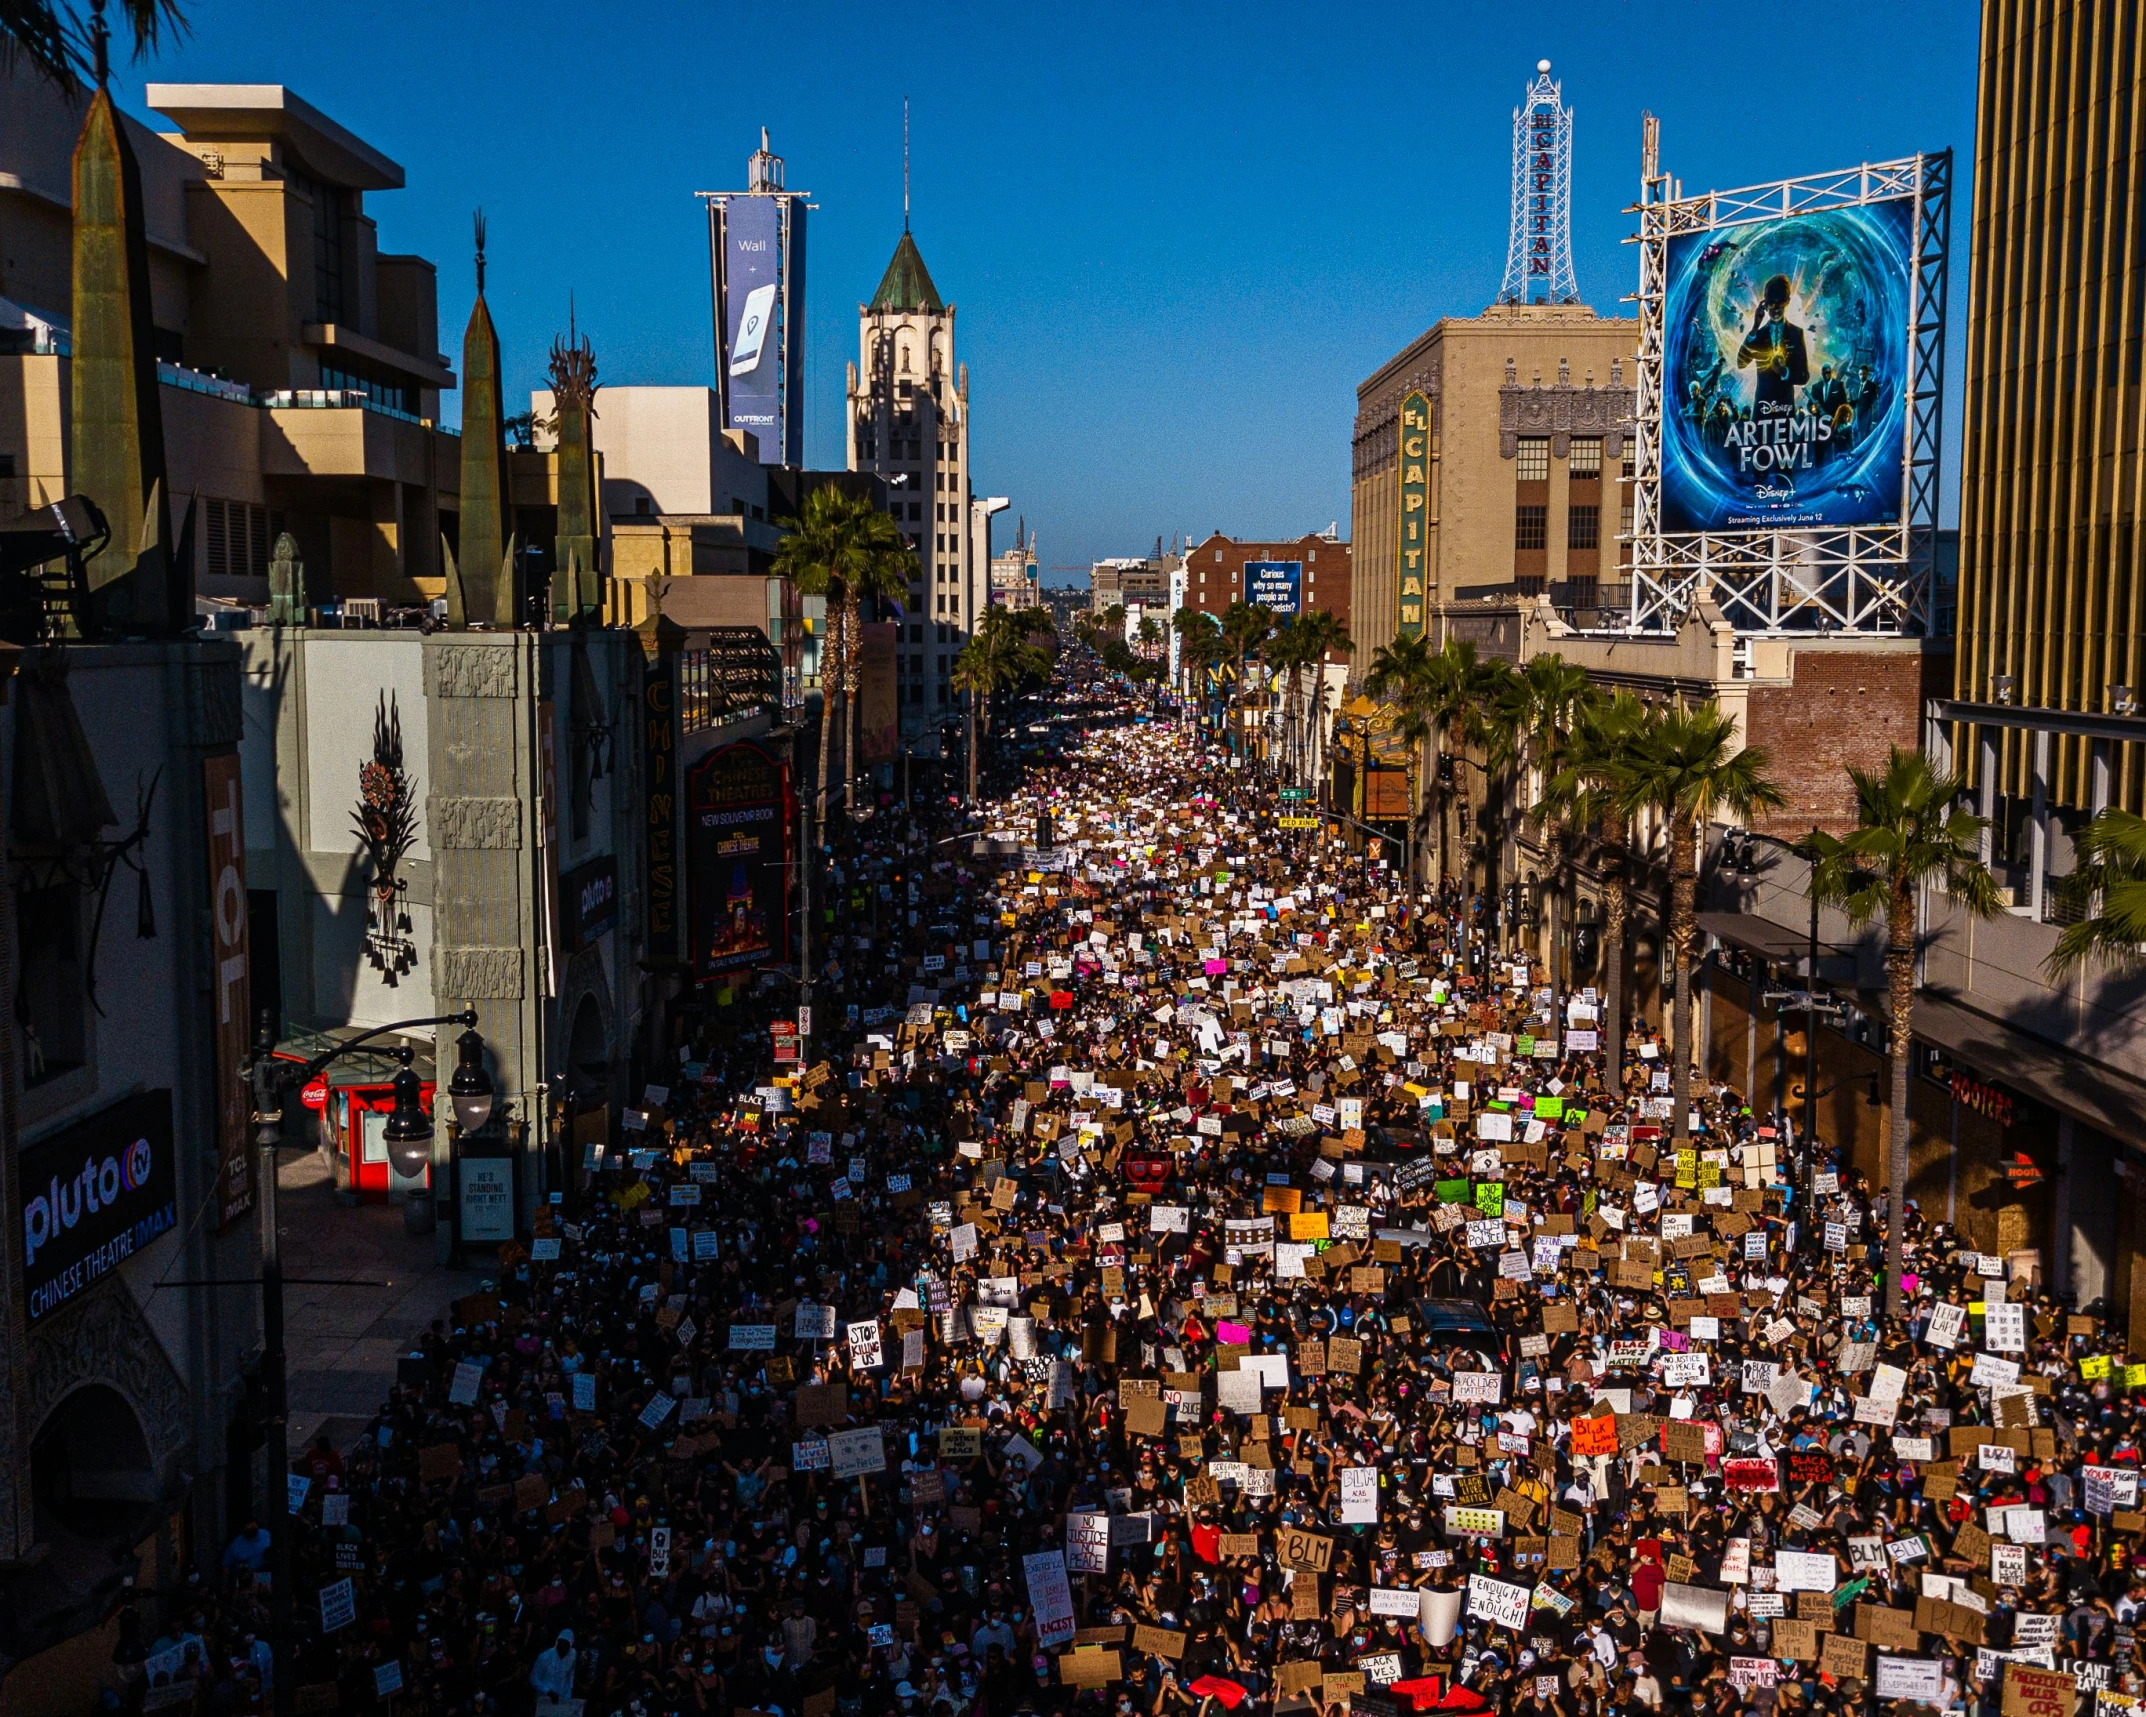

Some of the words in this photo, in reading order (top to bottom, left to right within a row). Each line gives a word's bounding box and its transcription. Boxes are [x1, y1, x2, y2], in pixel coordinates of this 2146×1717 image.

[1530, 131, 1553, 275] CAPITAN
[738, 240, 766, 252] Wall
[734, 415, 774, 423] OUTFRONT
[1404, 409, 1427, 431] EL
[1723, 414, 1832, 448] ARTEMIS
[1740, 442, 1813, 472] FOWL
[1728, 515, 1760, 525] Streaming
[1761, 513, 1796, 524] Exclusively
[1797, 513, 1814, 521] June
[1814, 512, 1823, 520] 12
[1402, 436, 1424, 624] CAPITAN
[1260, 568, 1285, 579] Curious
[1252, 580, 1266, 592] why
[1266, 582, 1275, 590] so
[1275, 582, 1293, 592] many
[1256, 592, 1277, 603] people
[1277, 593, 1288, 601] are
[647, 680, 673, 933] CHINESE
[702, 814, 719, 826] NEW
[720, 809, 754, 824] SOUVENIR
[756, 808, 775, 820] BOOK
[582, 879, 604, 920] pluto
[716, 958, 728, 968] SALE
[739, 1094, 763, 1105] BLACK
[745, 1112, 759, 1121] NOT
[1605, 1126, 1627, 1134] DEFUND
[1603, 1136, 1627, 1146] POLICE
[1678, 1149, 1695, 1159] BLACK
[228, 1154, 248, 1176] TCL
[1677, 1160, 1695, 1168] LIVES
[478, 1172, 494, 1182] HE'S
[468, 1183, 503, 1193] STANDING
[466, 1194, 487, 1204] RIGHT
[488, 1194, 507, 1203] NEXT
[25, 1156, 119, 1266] pluto
[1468, 1219, 1503, 1232] ABOLISH
[1468, 1231, 1504, 1246] POLICE!
[1536, 1235, 1561, 1245] DEFUND
[30, 1267, 83, 1319] CHINESE
[84, 1228, 134, 1283] THEATRE
[135, 1201, 175, 1249] IMAX
[930, 1281, 945, 1291] HIS
[979, 1282, 990, 1290] No
[989, 1288, 1011, 1296] Justice
[919, 1286, 927, 1311] SAY
[931, 1291, 948, 1300] HER
[951, 1280, 959, 1310] NAME
[851, 1326, 877, 1344] STOP
[1659, 1330, 1689, 1351] BLM
[851, 1341, 880, 1357] KILLING
[1301, 1345, 1322, 1354] BLACK
[1614, 1342, 1650, 1350] BLACK
[1615, 1349, 1647, 1357] LIVES
[1675, 1354, 1700, 1363] JUSTICE
[862, 1354, 875, 1366] US
[1301, 1354, 1323, 1364] LIVES
[1609, 1357, 1642, 1365] MATTER
[1301, 1362, 1325, 1371] MATTER
[1334, 1361, 1355, 1370] PEACE
[1676, 1363, 1695, 1371] PEACE
[1752, 1362, 1771, 1372] BLACK
[1751, 1371, 1771, 1381] LIVES
[1749, 1380, 1771, 1390] MATTER
[1164, 1391, 1182, 1406] NO
[1575, 1420, 1606, 1436] Black
[1667, 1423, 1702, 1438] DEFUND
[799, 1442, 826, 1450] BLACK
[1575, 1443, 1613, 1454] Matter
[797, 1450, 826, 1458] LIVES
[1983, 1448, 2012, 1460] RAZA
[1725, 1460, 1778, 1469] CONVICT
[1790, 1456, 1829, 1468] BLACK
[1213, 1464, 1241, 1472] SCREAM
[1798, 1465, 1826, 1474] LIVES
[1248, 1470, 1270, 1479] BLACK
[1344, 1469, 1376, 1488] BLM
[1790, 1472, 1833, 1483] MATTER!
[2084, 1468, 2111, 1481] YOUR
[2113, 1471, 2138, 1482] FIGHT
[1247, 1478, 1267, 1486] LIVES
[1460, 1477, 1482, 1487] BLACK
[1247, 1485, 1273, 1494] MATTER
[1461, 1486, 1483, 1494] LIVES
[1459, 1493, 1488, 1504] MATTER
[1081, 1516, 1095, 1528] NO
[1068, 1529, 1107, 1543] JUSTICE
[335, 1543, 359, 1551] BLACK
[1289, 1535, 1328, 1567] BLM
[1891, 1538, 1923, 1559] BLM
[335, 1552, 357, 1560] LIVES
[652, 1549, 668, 1559] BLM
[1849, 1544, 1883, 1562] BLM
[335, 1561, 366, 1570] MATTER
[1069, 1553, 1104, 1569] PEACE
[1420, 1558, 1447, 1567] MATTER
[1999, 1561, 2023, 1571] BLACK
[2000, 1570, 2023, 1579] LIVES
[1470, 1577, 1520, 1600] #ENOUGH
[1486, 1591, 1502, 1603] IS
[1540, 1585, 1555, 1598] MY
[1553, 1595, 1572, 1610] LIFE
[1468, 1596, 1525, 1628] ENOUGH!
[1041, 1616, 1073, 1636] RACIST
[1931, 1604, 1980, 1637] BLM
[1827, 1637, 1864, 1654] stronger
[1359, 1656, 1393, 1669] BLACK
[1826, 1649, 1863, 1667] together
[2073, 1660, 2111, 1680] CANT
[2011, 1668, 2075, 1691] PROSECUTE
